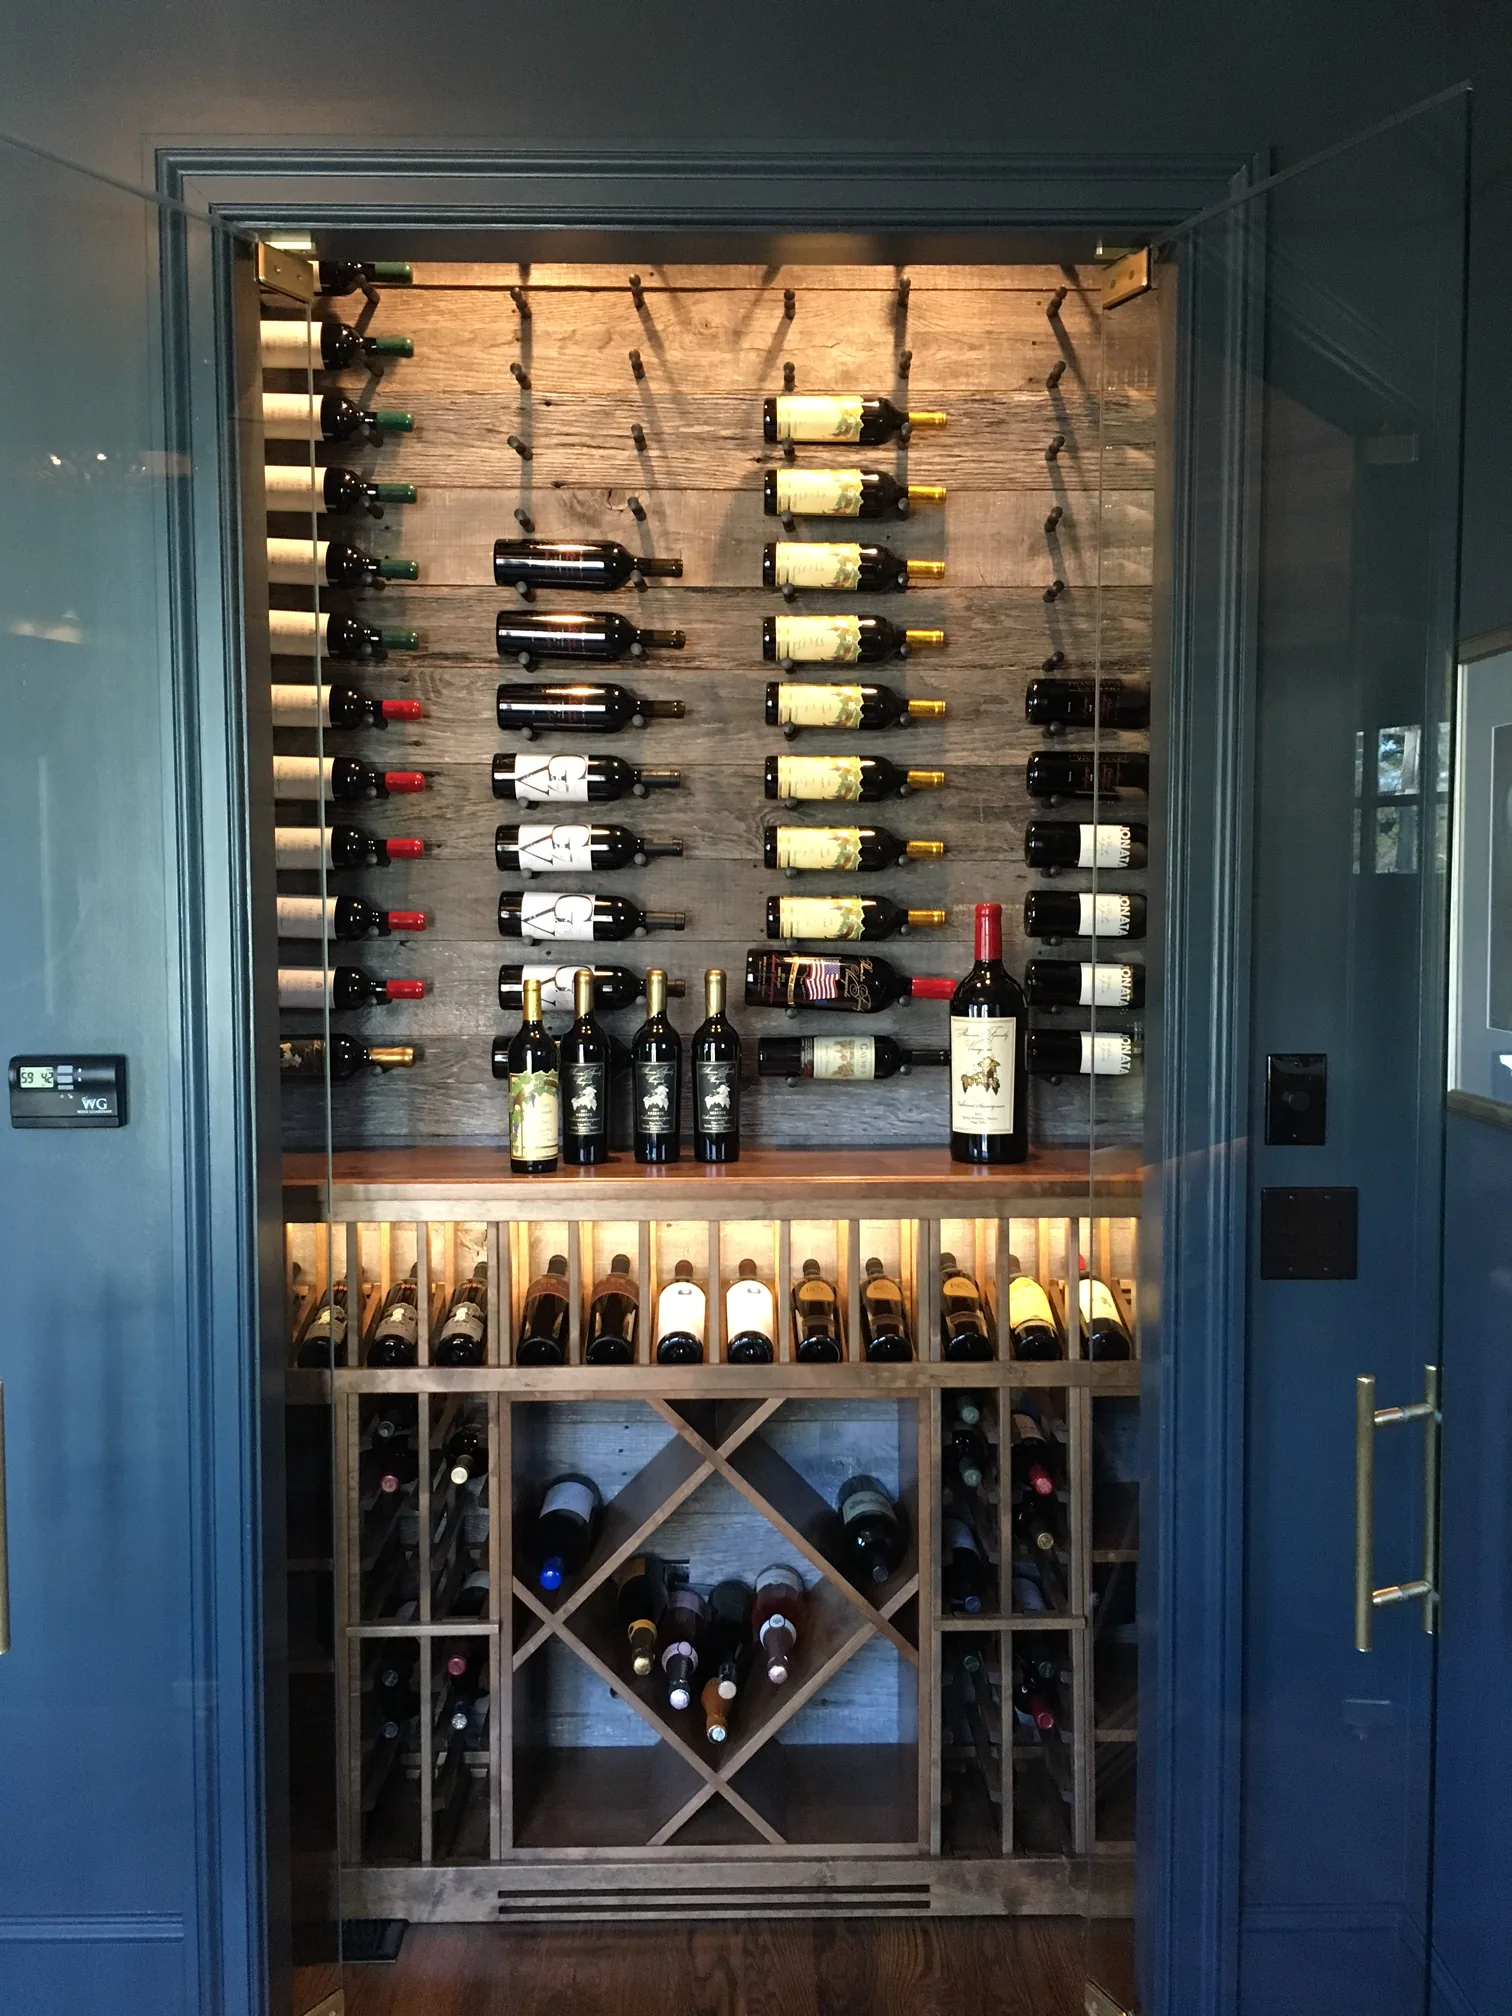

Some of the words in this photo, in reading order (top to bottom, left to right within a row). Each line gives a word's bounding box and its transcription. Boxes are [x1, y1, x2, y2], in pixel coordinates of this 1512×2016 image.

[1117, 826, 1132, 868] JONATA
[1117, 894, 1132, 936] JONATA
[81, 1097, 107, 1110] WG
